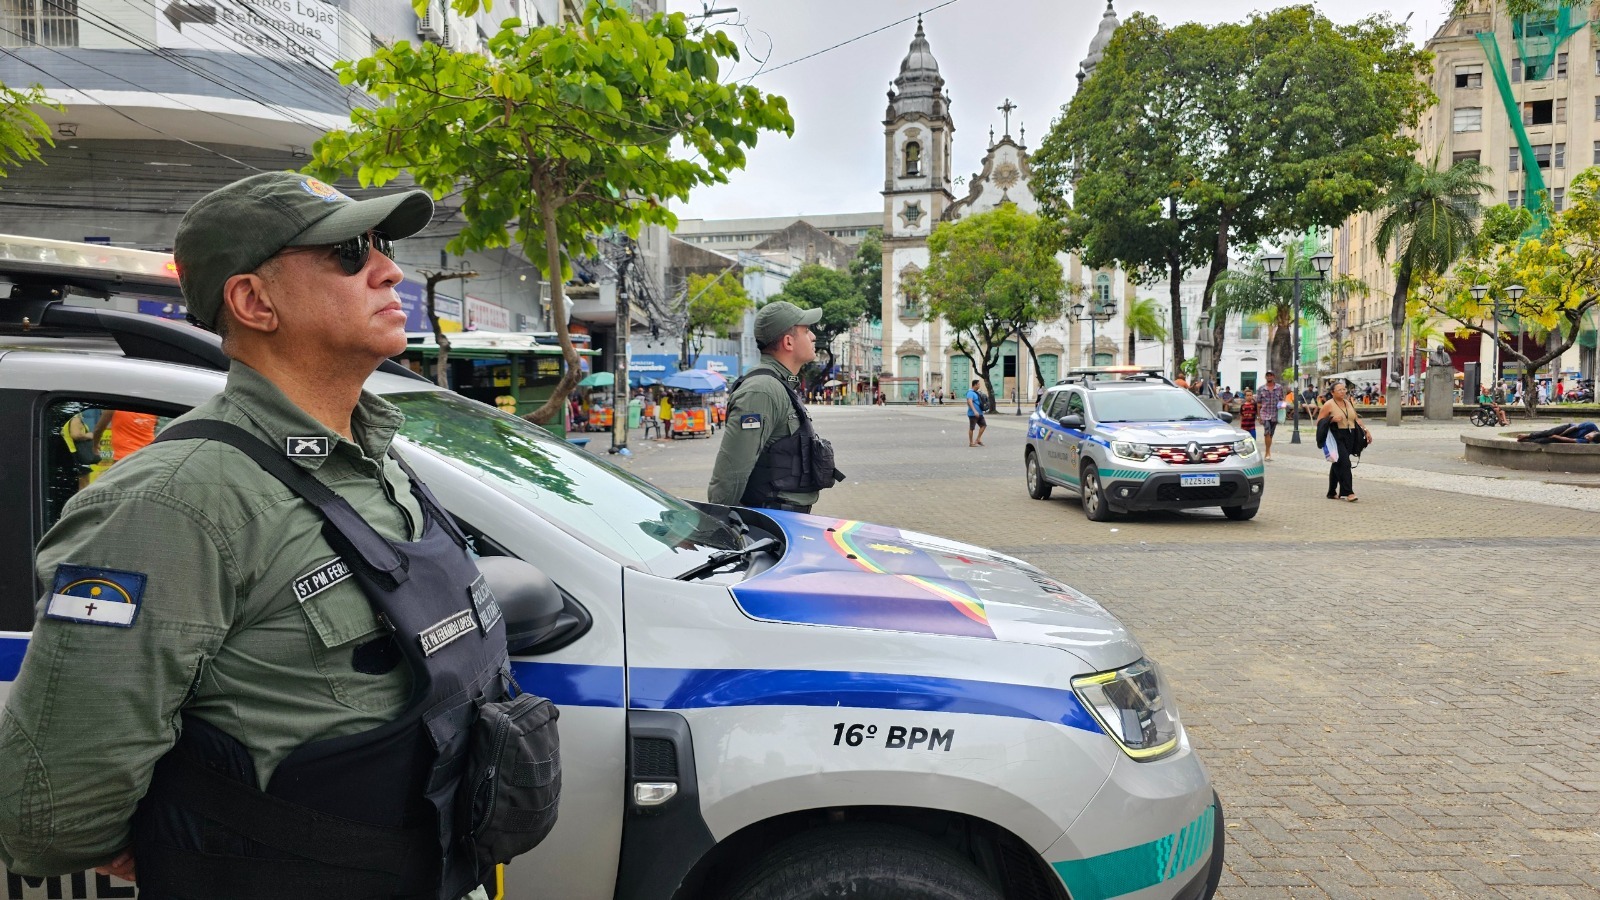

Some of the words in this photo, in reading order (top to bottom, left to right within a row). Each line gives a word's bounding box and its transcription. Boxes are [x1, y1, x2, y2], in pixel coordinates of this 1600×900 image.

[223, 8, 322, 40] Reformadas
[297, 1, 334, 25] Lojas
[298, 580, 312, 596] ST
[312, 571, 329, 589] PM
[422, 635, 432, 651] ST
[428, 631, 440, 647] PM
[885, 725, 955, 752] BPM
